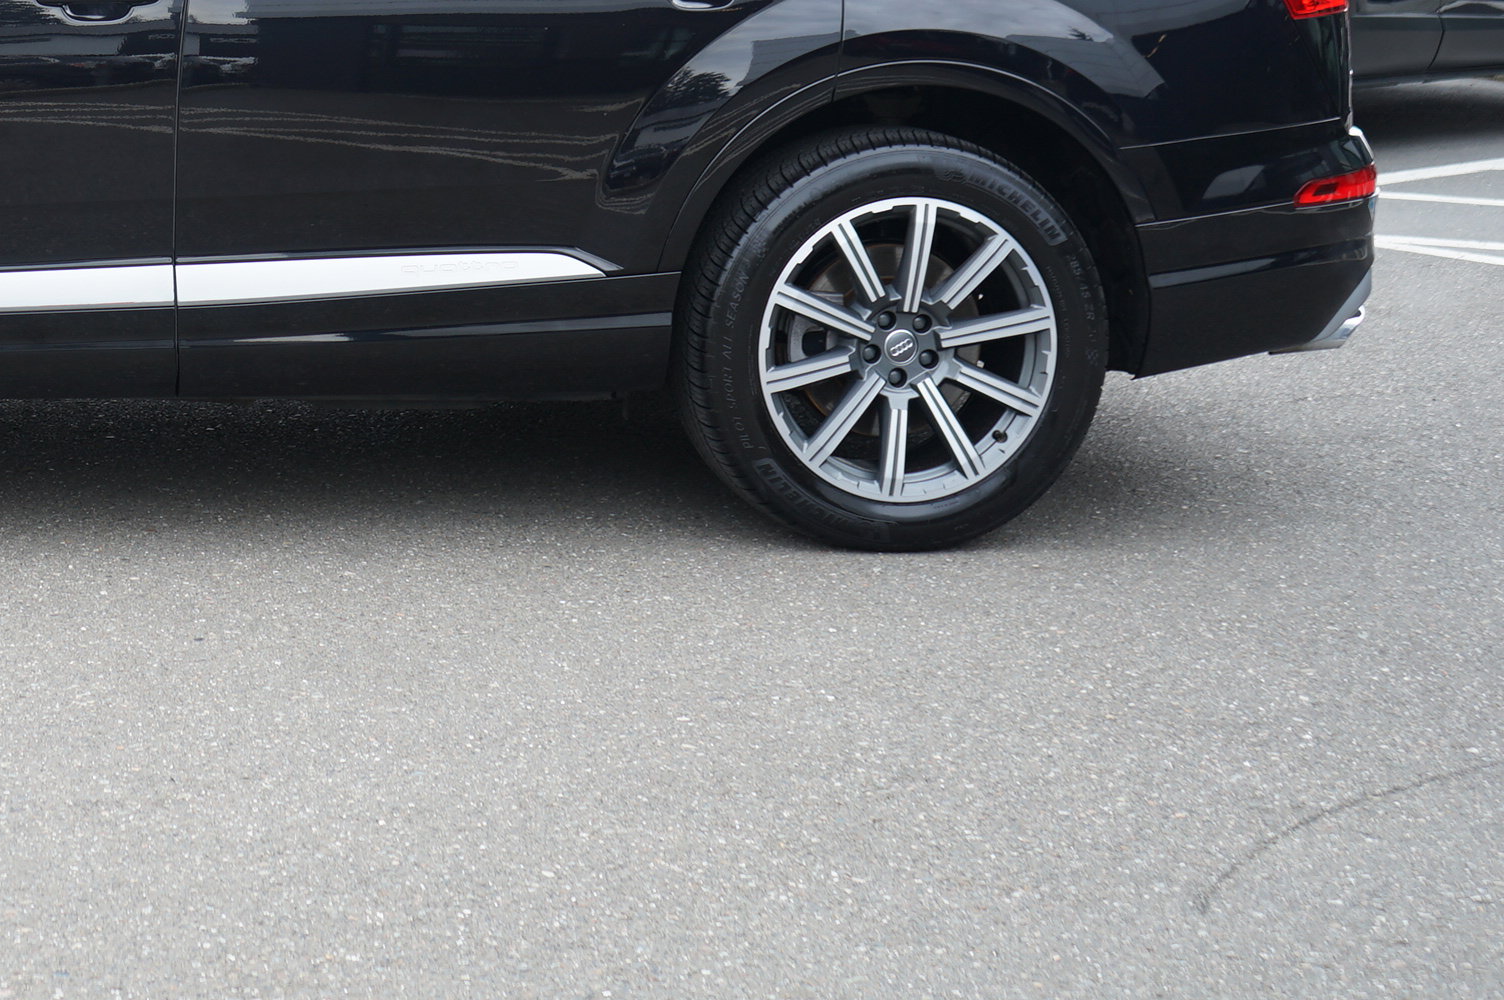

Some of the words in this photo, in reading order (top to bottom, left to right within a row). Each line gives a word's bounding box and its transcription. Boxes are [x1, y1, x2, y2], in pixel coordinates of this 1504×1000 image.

[969, 174, 1062, 241] MICHELIN
[400, 259, 519, 278] quattro
[725, 272, 750, 329] SEASON
